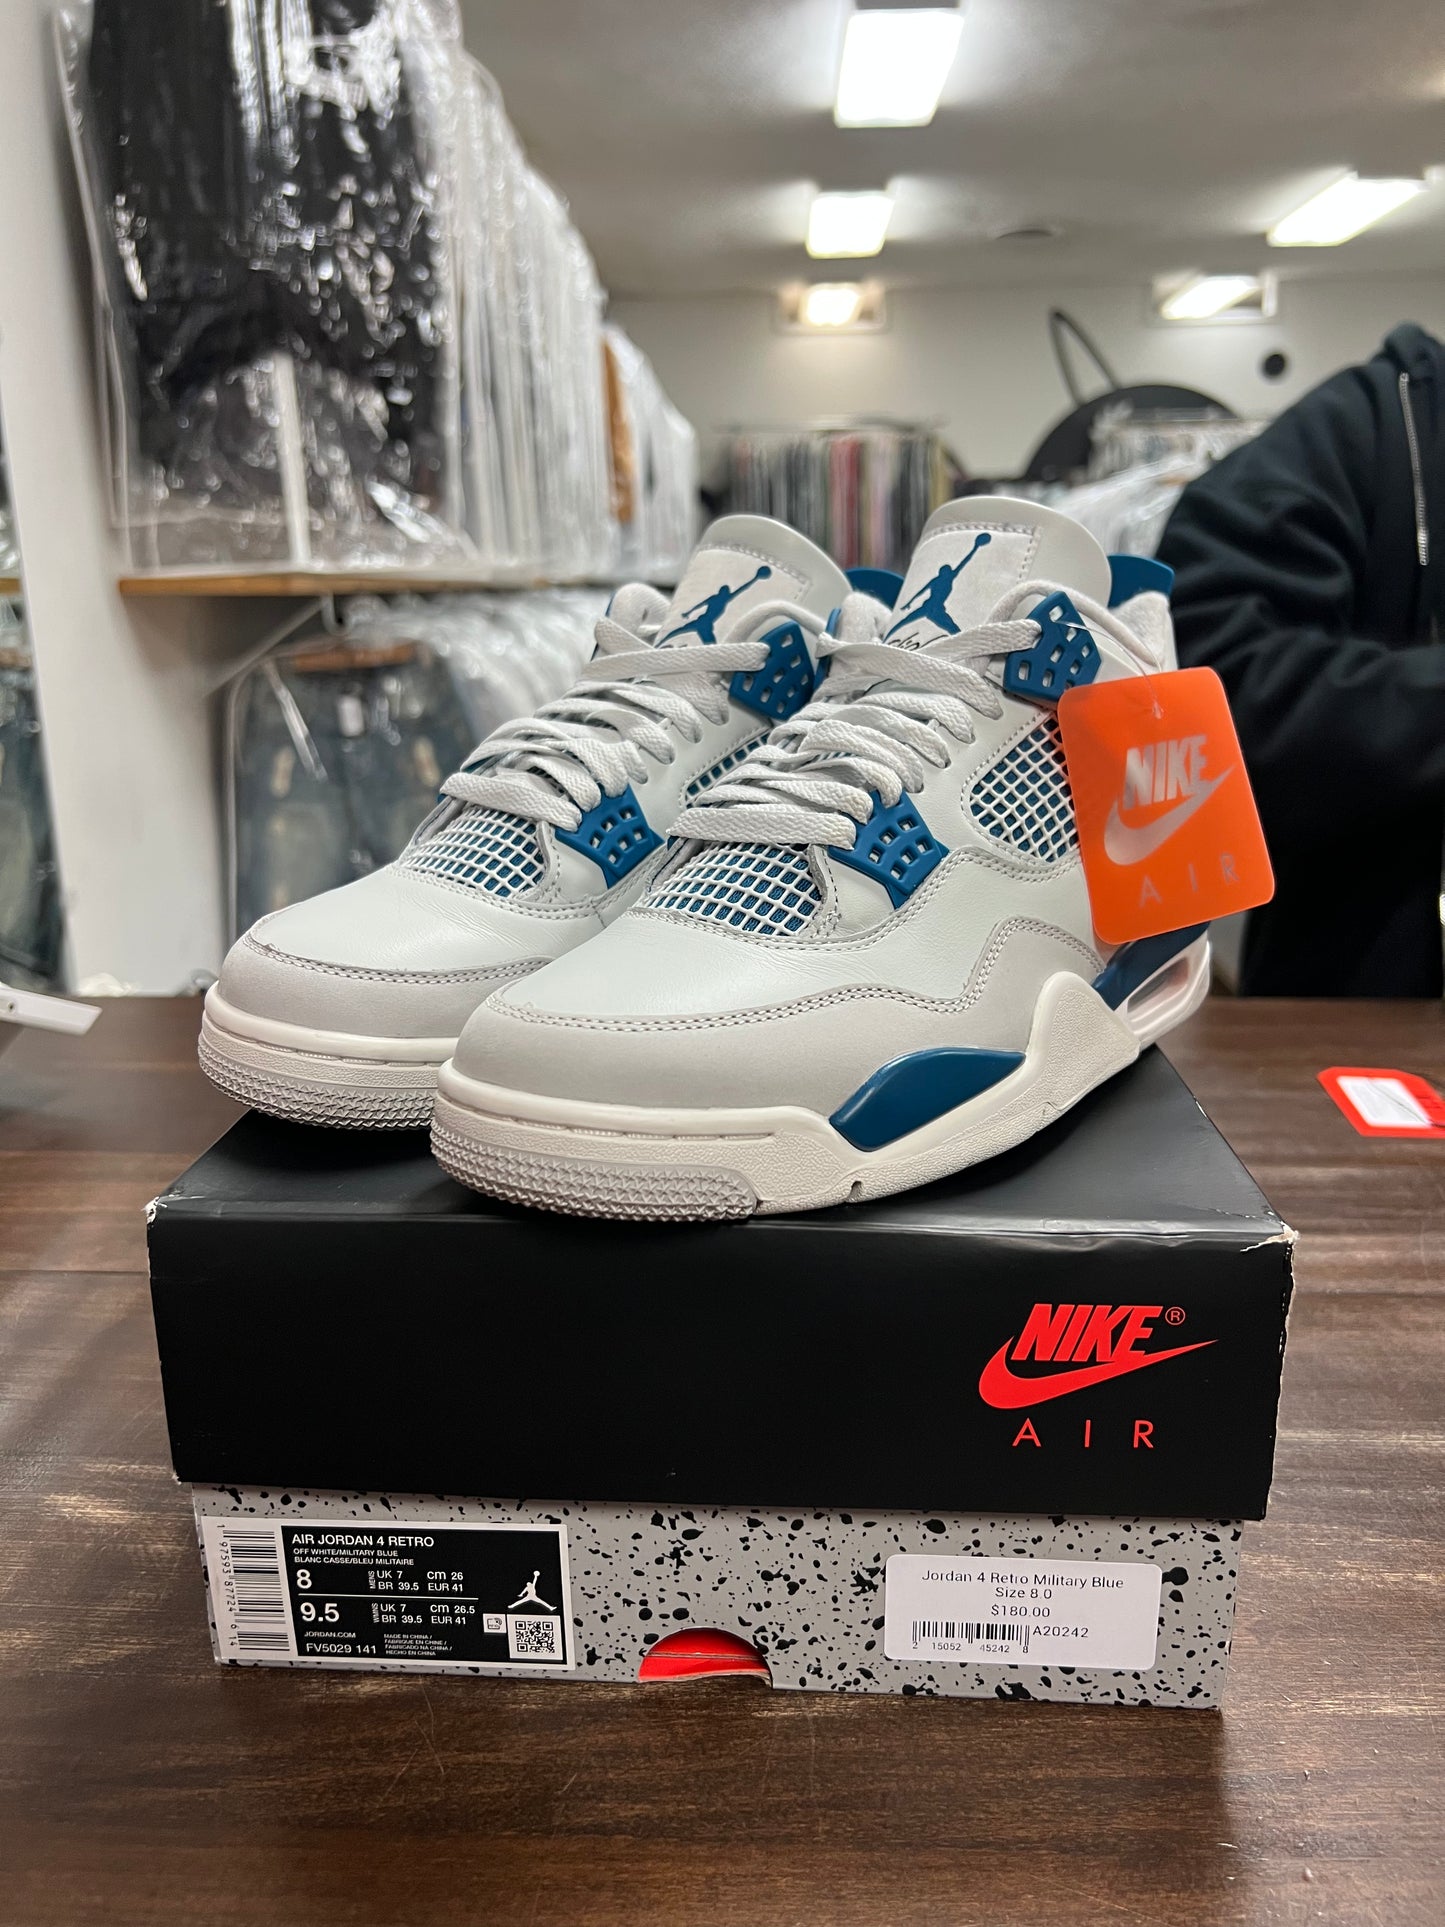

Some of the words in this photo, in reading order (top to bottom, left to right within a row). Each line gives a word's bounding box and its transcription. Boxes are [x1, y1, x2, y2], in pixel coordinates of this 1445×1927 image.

[1122, 734, 1208, 811] NIKE
[1138, 852, 1240, 908] AIR
[1010, 1303, 1164, 1362] NIKE
[1011, 1417, 1154, 1449] AIR
[292, 1533, 315, 1545] AIR
[317, 1534, 374, 1546] JORDAN
[376, 1536, 385, 1546] 4
[388, 1535, 435, 1547] RETRO
[375, 1558, 415, 1566] MILITAIRE
[296, 1568, 313, 1590] 8
[376, 1570, 393, 1579] UK
[396, 1570, 403, 1579] 7
[426, 1571, 447, 1580] cm
[450, 1571, 464, 1581] 26
[921, 1570, 972, 1582] Jordan
[977, 1572, 986, 1583] 4
[990, 1572, 1029, 1585] Retro
[1033, 1574, 1087, 1589] Military
[1092, 1576, 1124, 1589] Blue
[378, 1581, 394, 1590] BR
[398, 1582, 419, 1591] 39.5
[428, 1582, 450, 1592] EUR
[452, 1583, 463, 1592] 41
[995, 1586, 1026, 1598] Size
[300, 1602, 340, 1623] 9.5
[380, 1603, 396, 1612] UK
[400, 1603, 407, 1612] 7
[430, 1604, 450, 1613] cm
[453, 1605, 475, 1614] 26.5
[991, 1603, 1051, 1618] $180.00
[381, 1614, 397, 1623] BR
[401, 1615, 423, 1624] 39.5
[431, 1615, 453, 1625] EUR
[455, 1616, 466, 1625] 41
[304, 1631, 356, 1639] JORDAN.COM
[1032, 1625, 1089, 1639] A20242
[306, 1643, 352, 1654] FV5029
[355, 1644, 377, 1655] 141
[931, 1642, 962, 1651] 15052
[979, 1644, 1010, 1653] 45242
